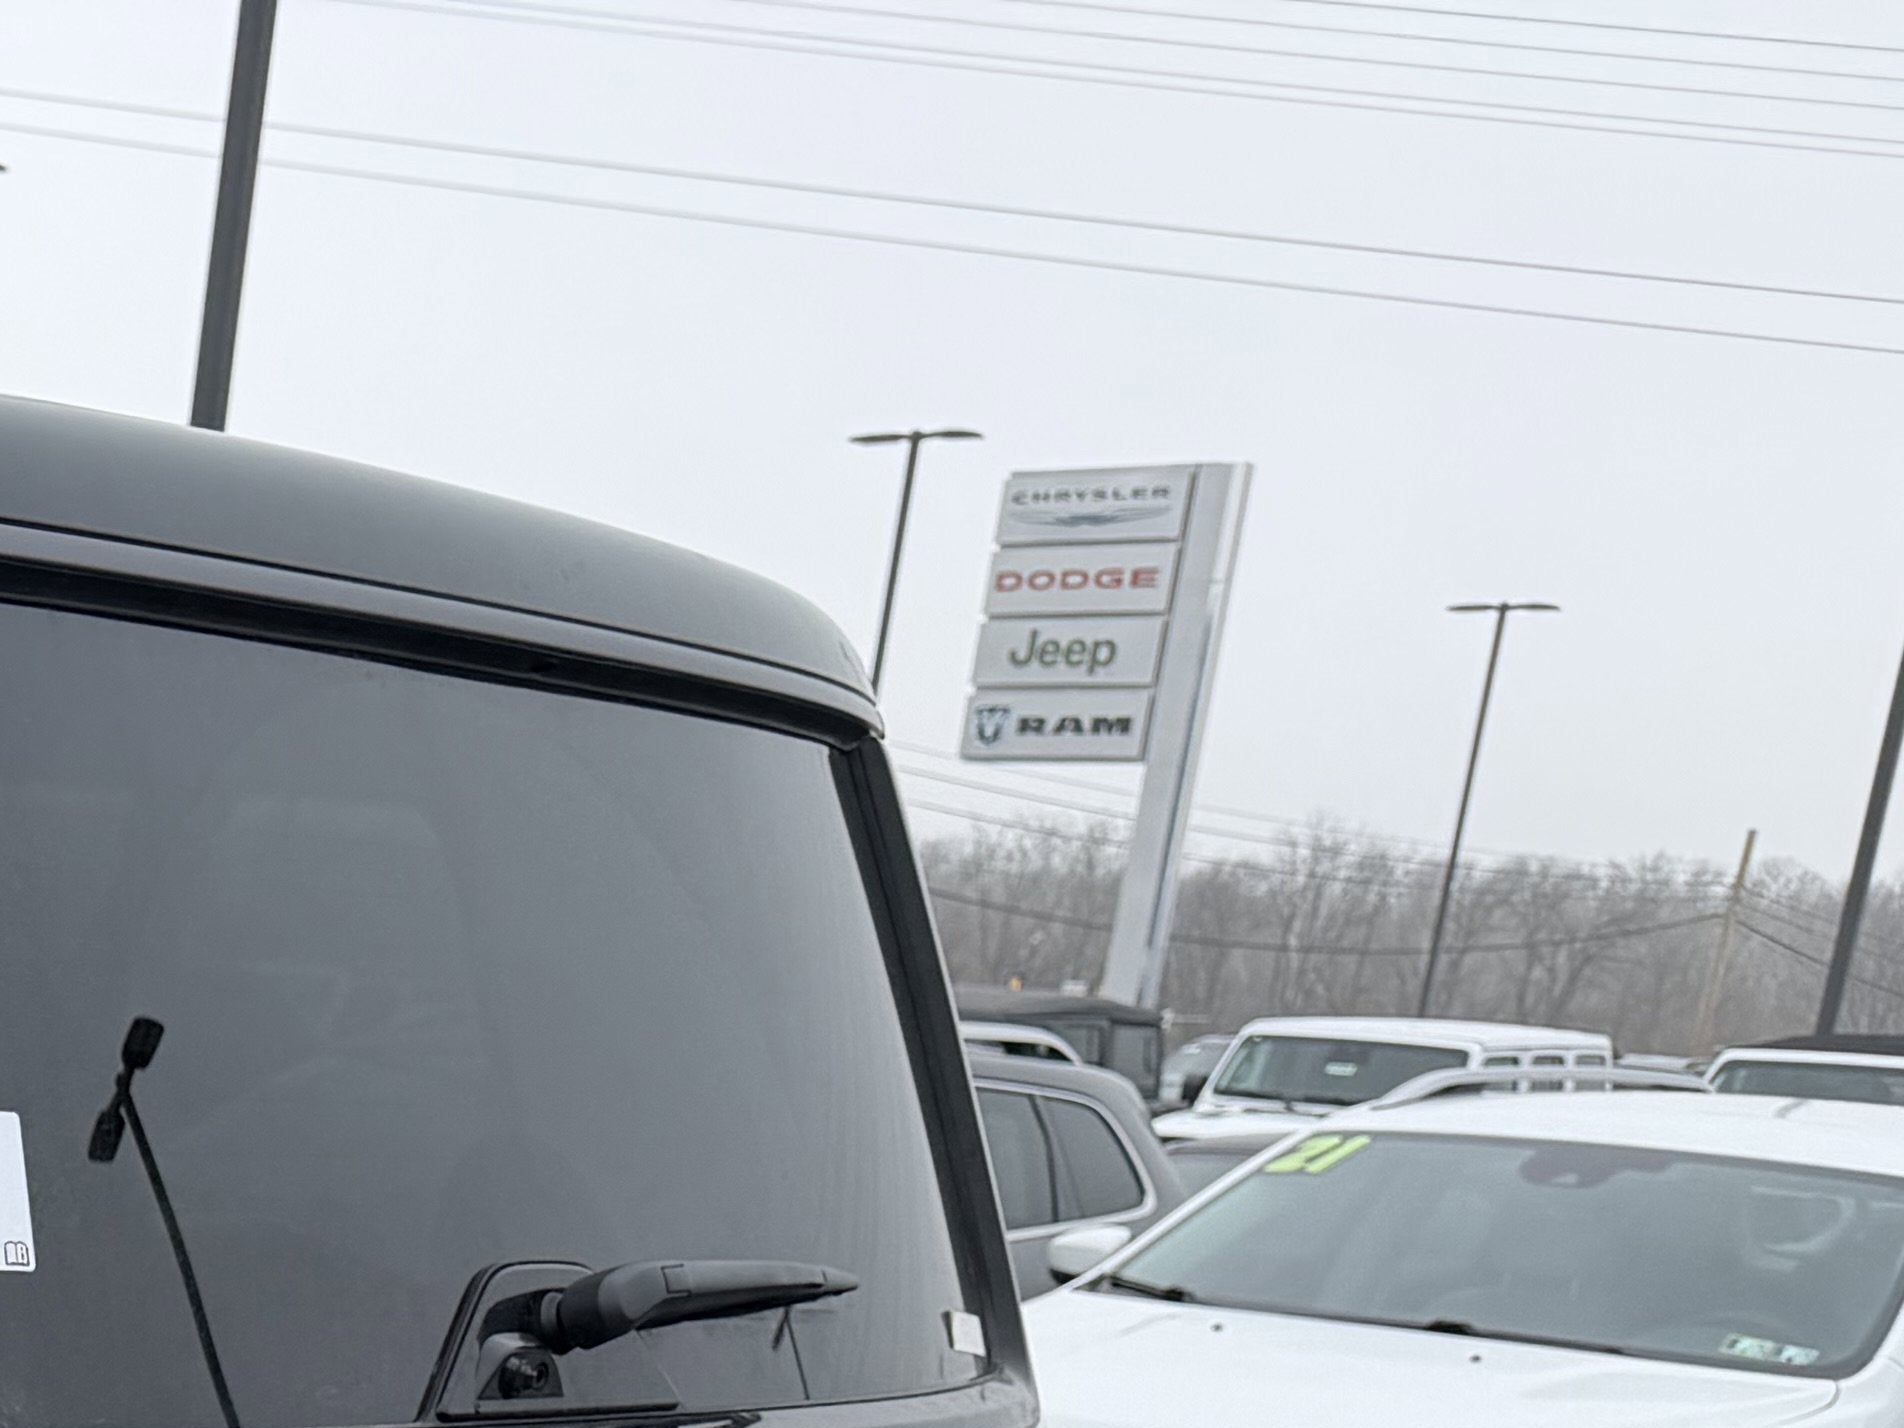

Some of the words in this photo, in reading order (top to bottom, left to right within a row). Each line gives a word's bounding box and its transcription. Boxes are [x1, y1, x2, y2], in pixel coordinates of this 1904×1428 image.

[1010, 484, 1171, 506] CHRYSLER
[995, 567, 1159, 593] DODGE
[1008, 628, 1117, 673] Jeep
[1015, 715, 1134, 736] RAM
